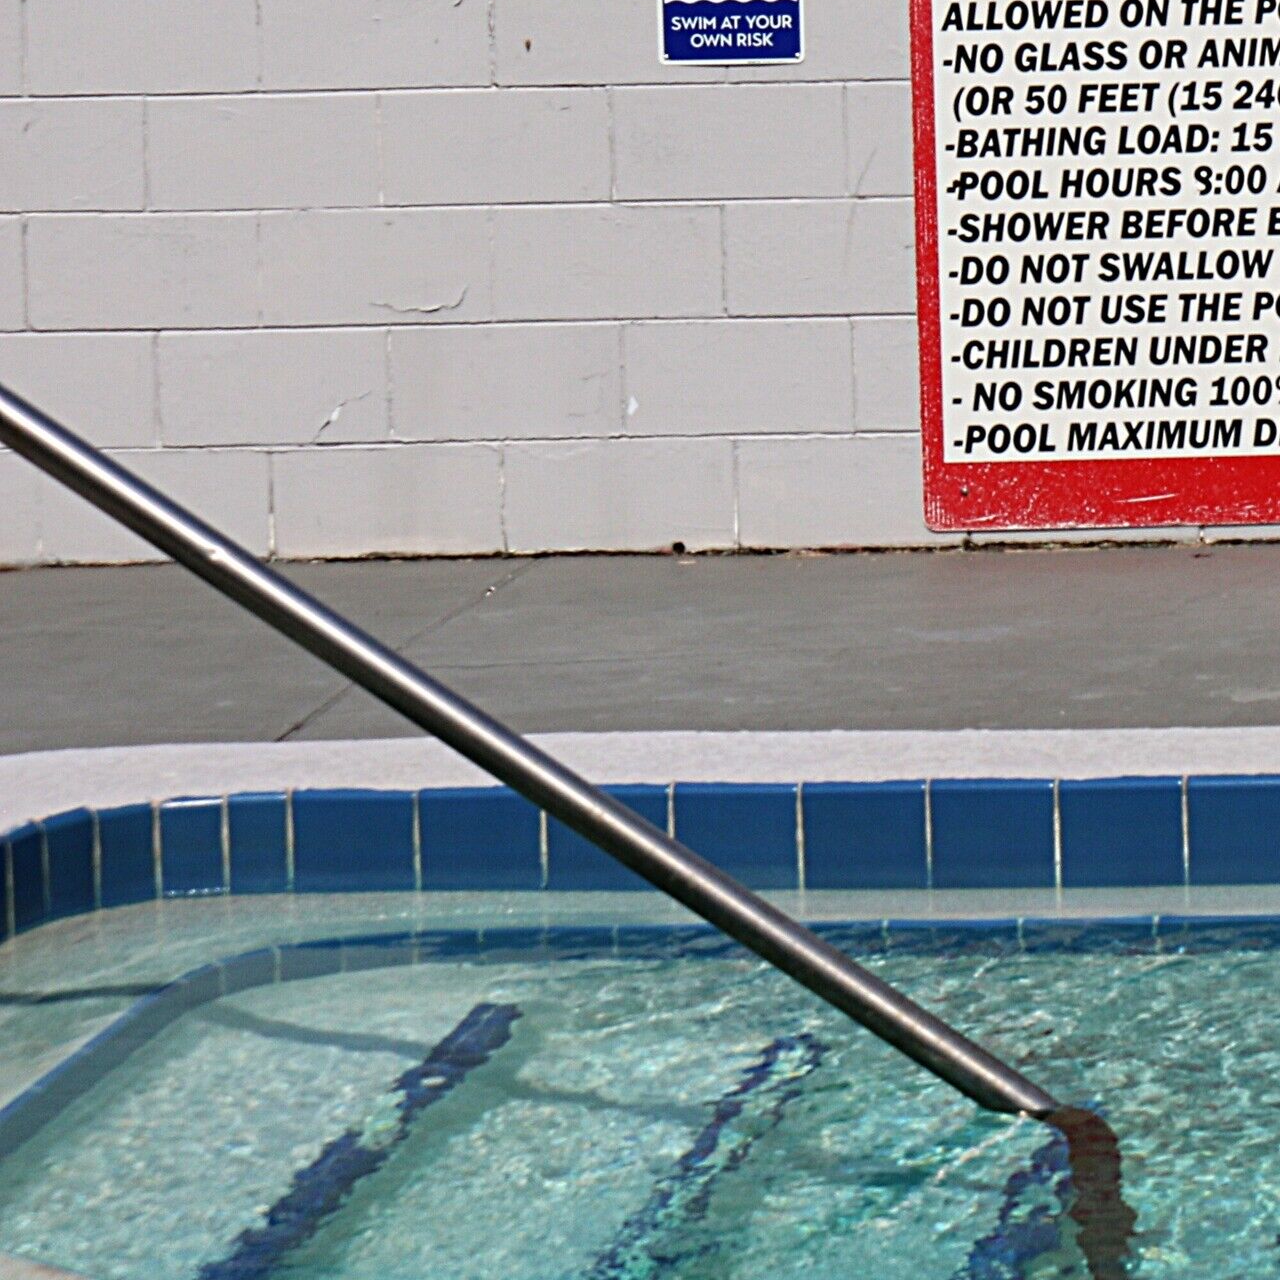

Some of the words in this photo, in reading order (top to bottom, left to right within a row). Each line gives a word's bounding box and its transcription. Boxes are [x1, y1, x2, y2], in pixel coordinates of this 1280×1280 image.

[671, 16, 717, 31] SWIM
[720, 15, 741, 30] AT
[745, 14, 792, 29] YOUR
[942, 0, 1108, 31] ALLOWED
[690, 33, 733, 48] OWN
[736, 32, 774, 47] RISK
[943, 44, 1003, 73] -NO
[1015, 41, 1127, 72] GLASS
[1139, 40, 1187, 69] OR
[954, 86, 1013, 122] (OR
[1025, 85, 1067, 114] 50
[1078, 83, 1160, 113] FEET
[1169, 82, 1222, 118] (15
[946, 126, 1106, 158] -BATHING
[1118, 125, 1219, 154] LOAD:
[1231, 123, 1272, 151] 15
[947, 170, 1048, 200] -POOL
[1061, 167, 1181, 198] HOURS
[948, 212, 1109, 242] -SHOWER
[1121, 208, 1257, 239] BEFORE
[949, 255, 1009, 284] -DO
[1021, 254, 1089, 283] NOT
[1099, 250, 1273, 282] SWALLOW
[950, 298, 1010, 327] -DO
[1022, 296, 1091, 325] NOT
[1101, 295, 1167, 324] USE
[1179, 293, 1242, 322] THE
[952, 337, 1138, 369] -CHILDREN
[1150, 335, 1268, 365] UNDER
[973, 382, 1022, 411] NO
[1033, 378, 1197, 410] SMOKING
[954, 424, 1055, 453] -POOL
[1068, 419, 1242, 451] MAXIMUM
